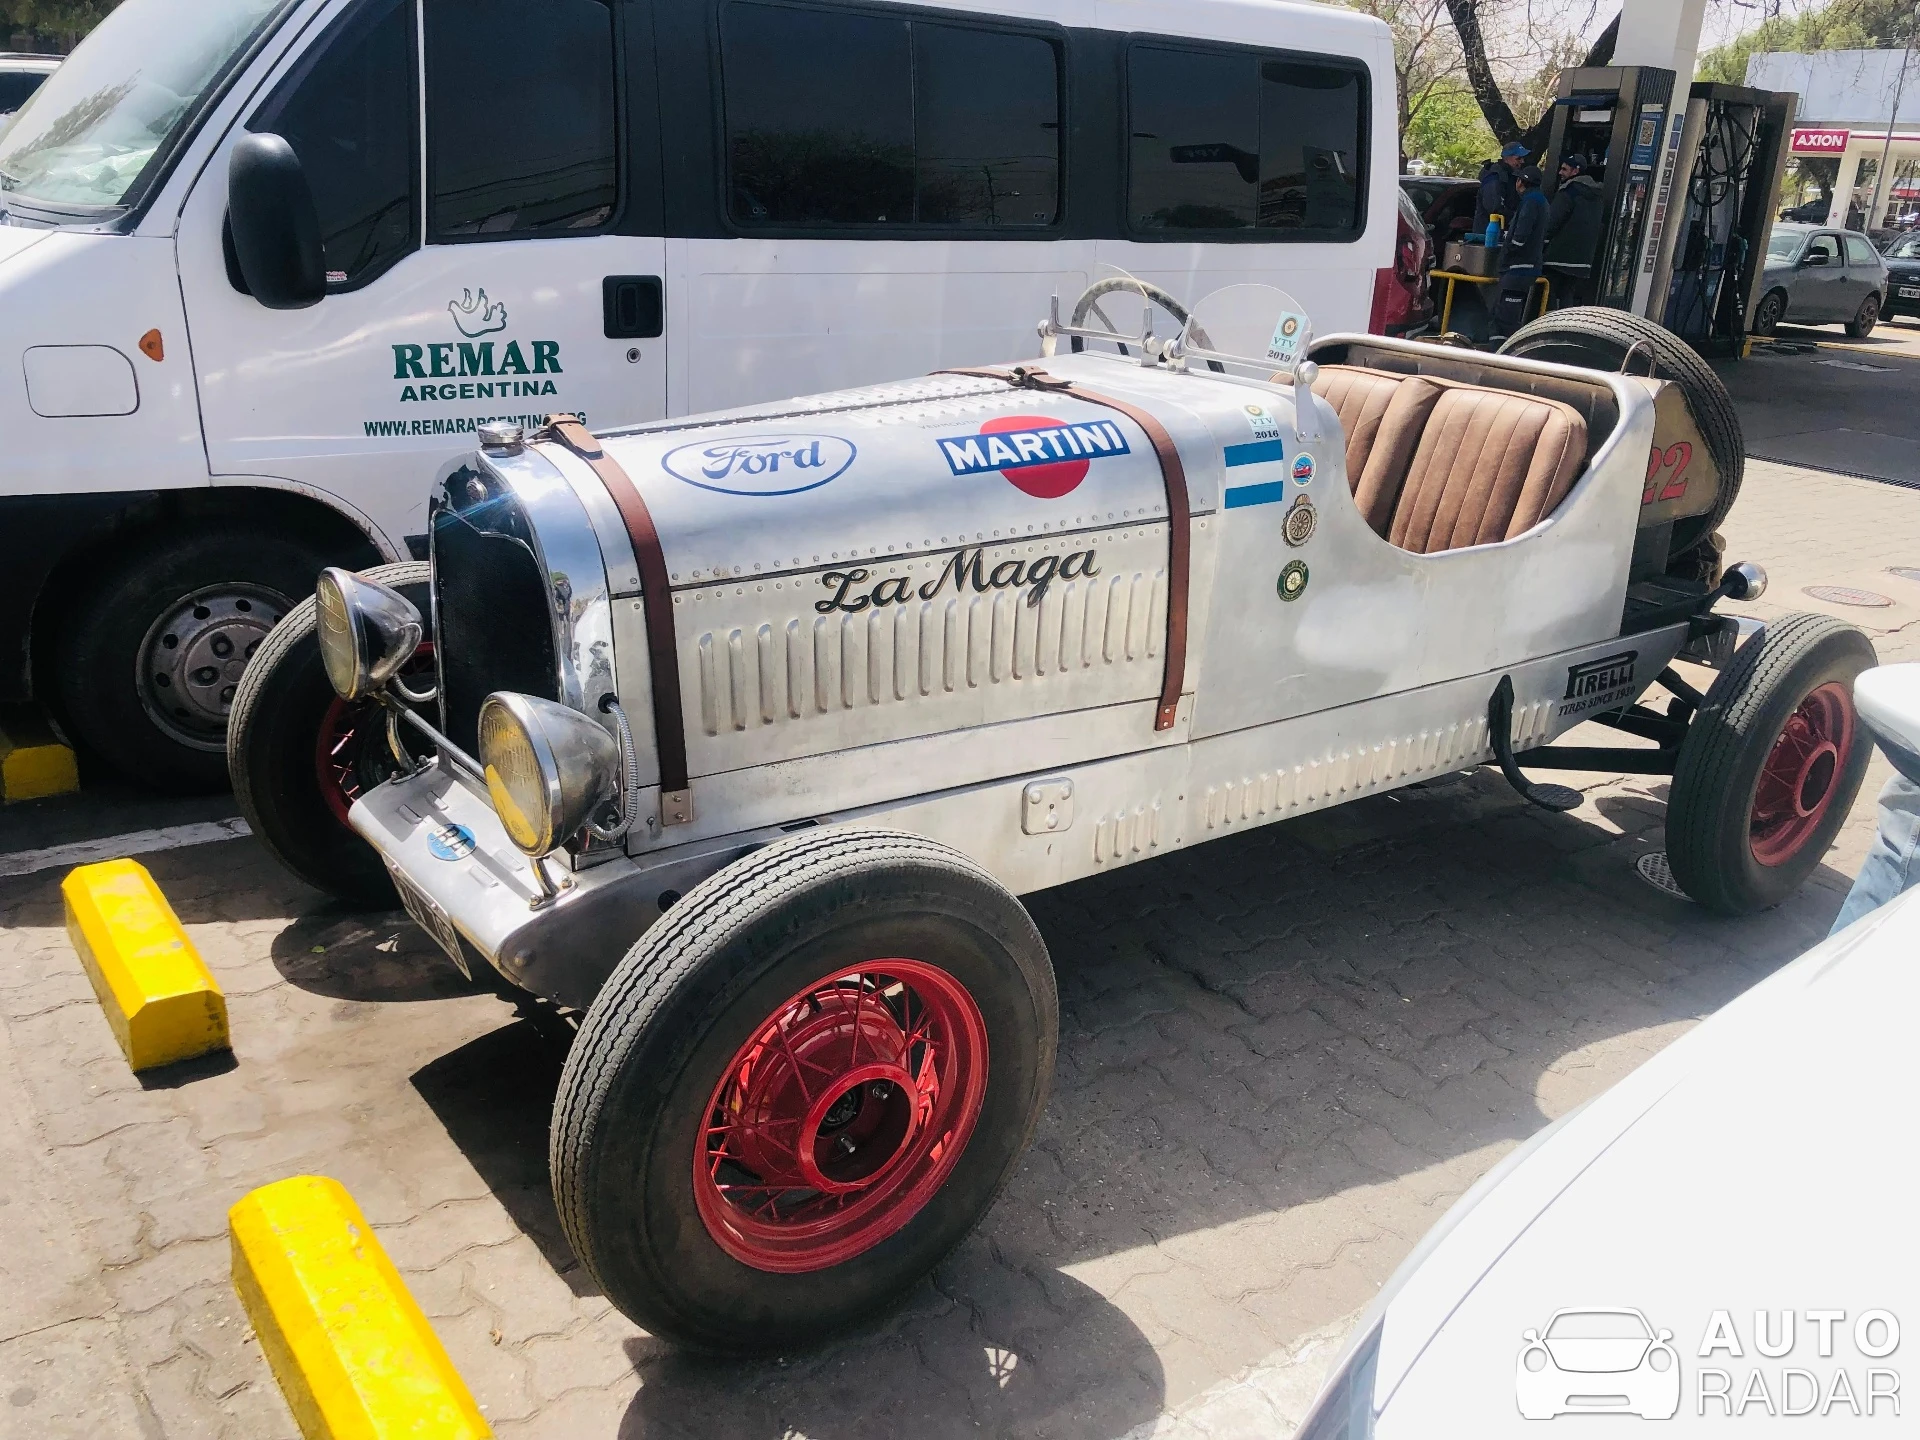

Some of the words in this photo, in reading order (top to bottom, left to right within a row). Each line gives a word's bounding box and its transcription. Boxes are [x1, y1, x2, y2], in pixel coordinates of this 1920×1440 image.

[1796, 134, 1844, 147] AXION
[1273, 336, 1297, 348] VTV
[392, 339, 563, 380] REMAR
[1266, 349, 1291, 362] 2019
[400, 380, 558, 402] ARGENTINA
[1250, 416, 1273, 425] VTV
[1254, 429, 1279, 439] 2016
[943, 423, 1124, 471] MARTINI
[702, 440, 827, 480] Ford
[814, 568, 914, 614] La
[918, 549, 1102, 609] Maga
[1563, 650, 1639, 700] PIRELLI
[1558, 700, 1588, 716] TYRES
[1588, 691, 1614, 708] SINCE
